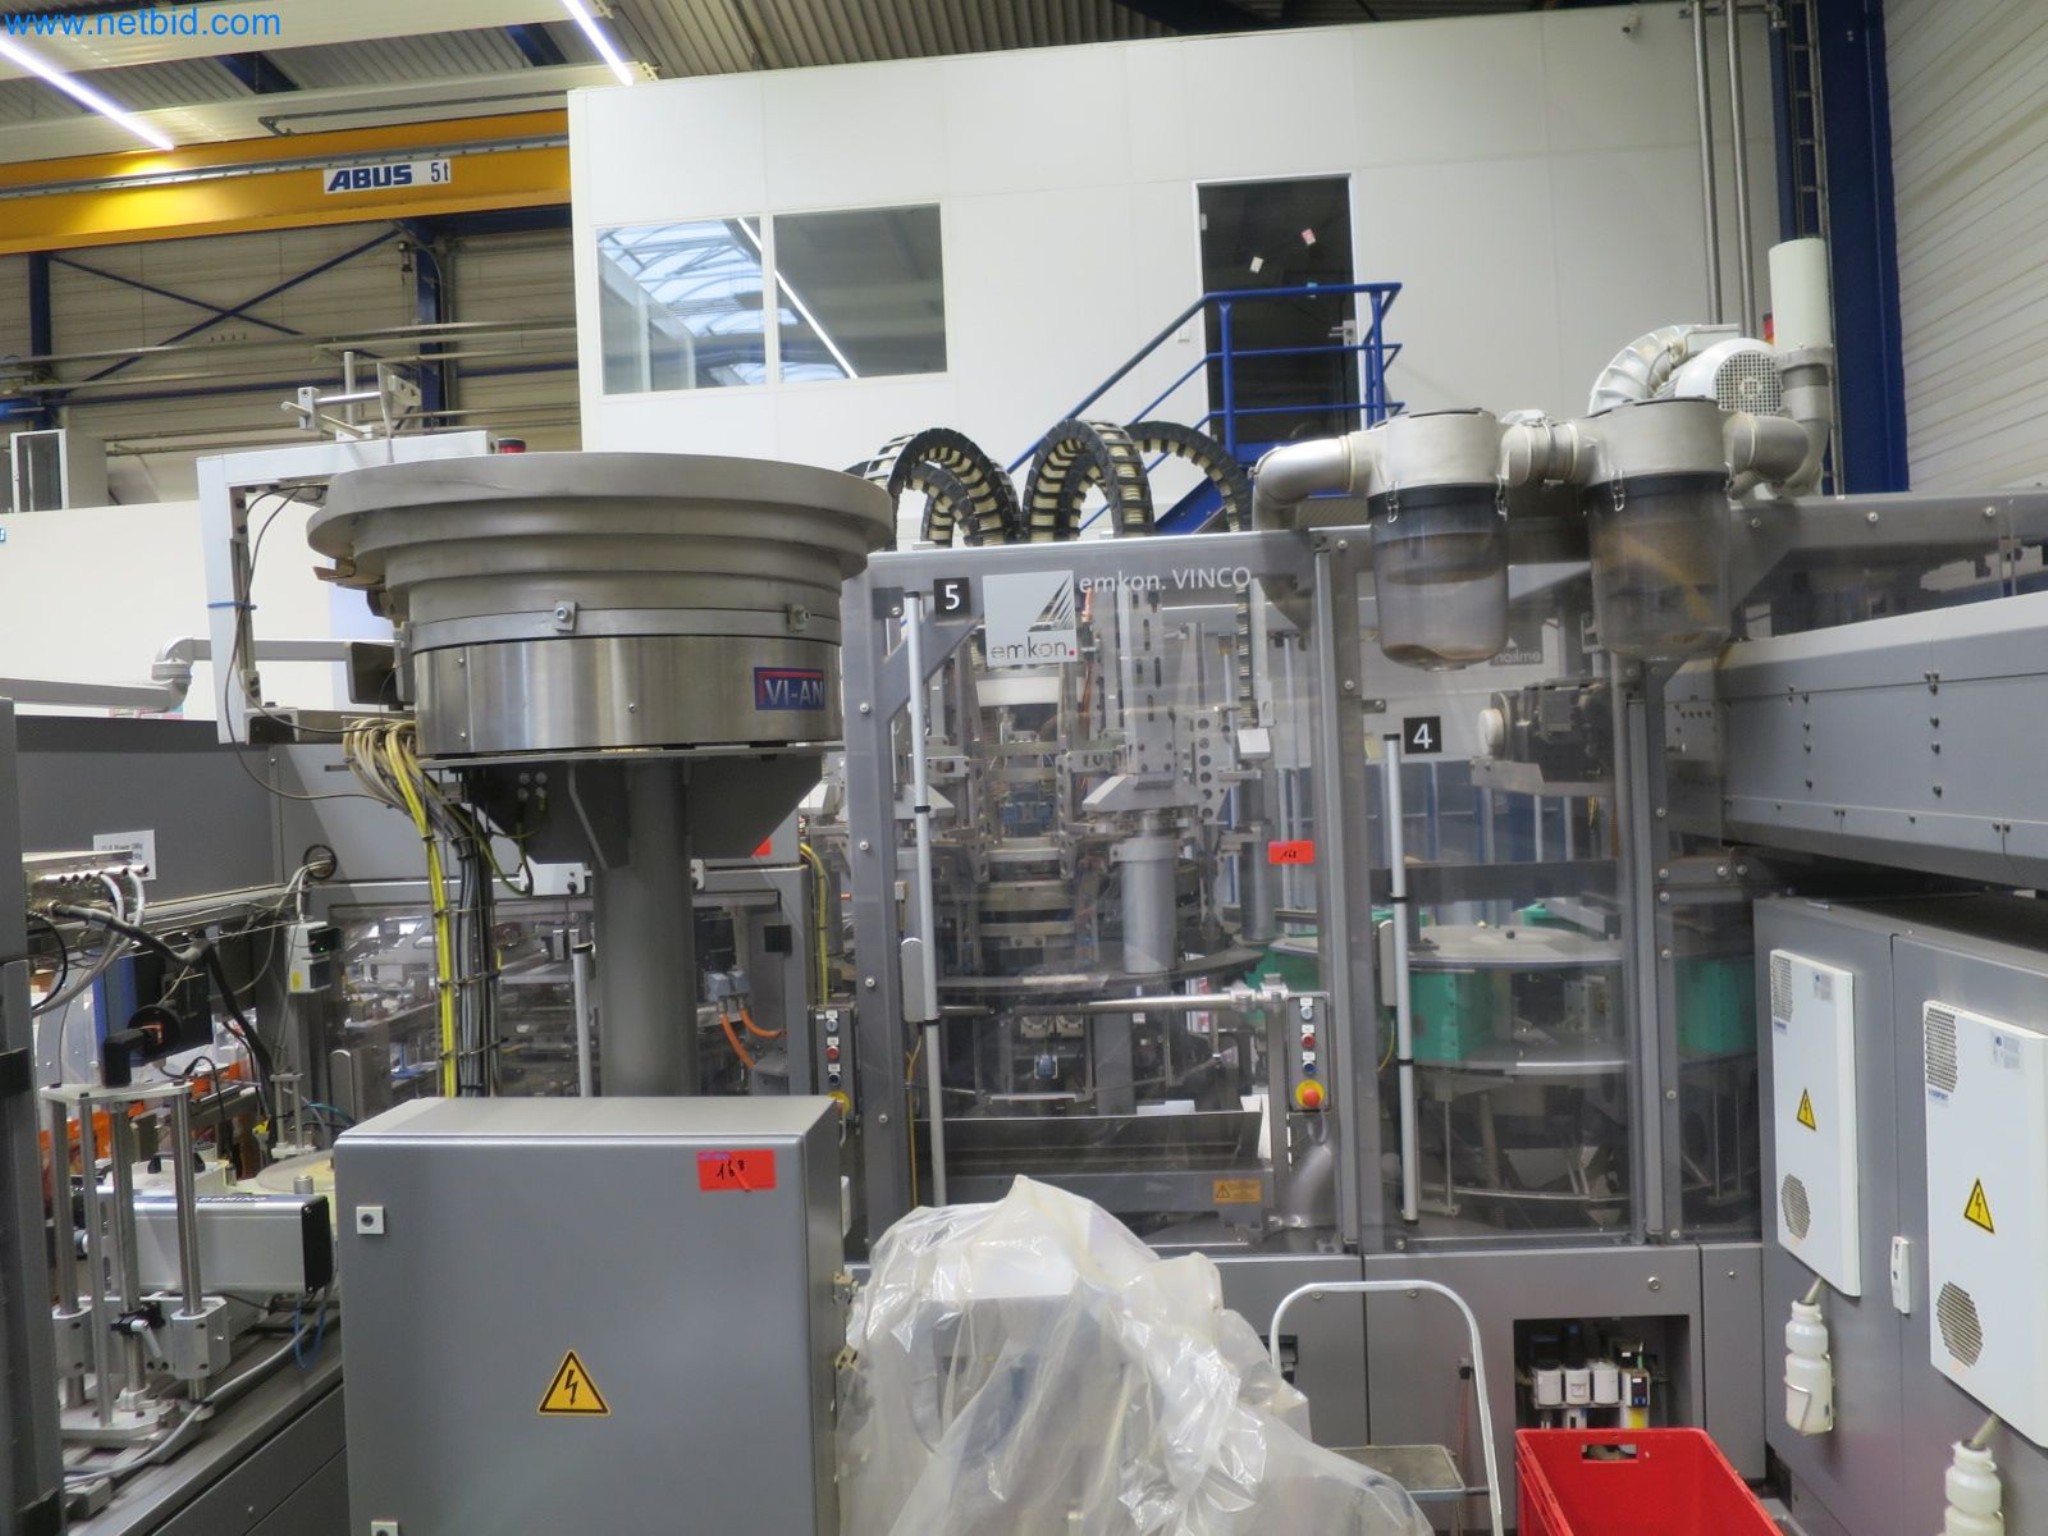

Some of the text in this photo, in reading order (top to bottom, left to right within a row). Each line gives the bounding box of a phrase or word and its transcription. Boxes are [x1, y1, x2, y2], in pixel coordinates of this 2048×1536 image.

[327, 164, 413, 192] ABUS
[1172, 567, 1250, 590] VINCO
[944, 584, 960, 610] 5
[1413, 723, 1433, 749] 4
